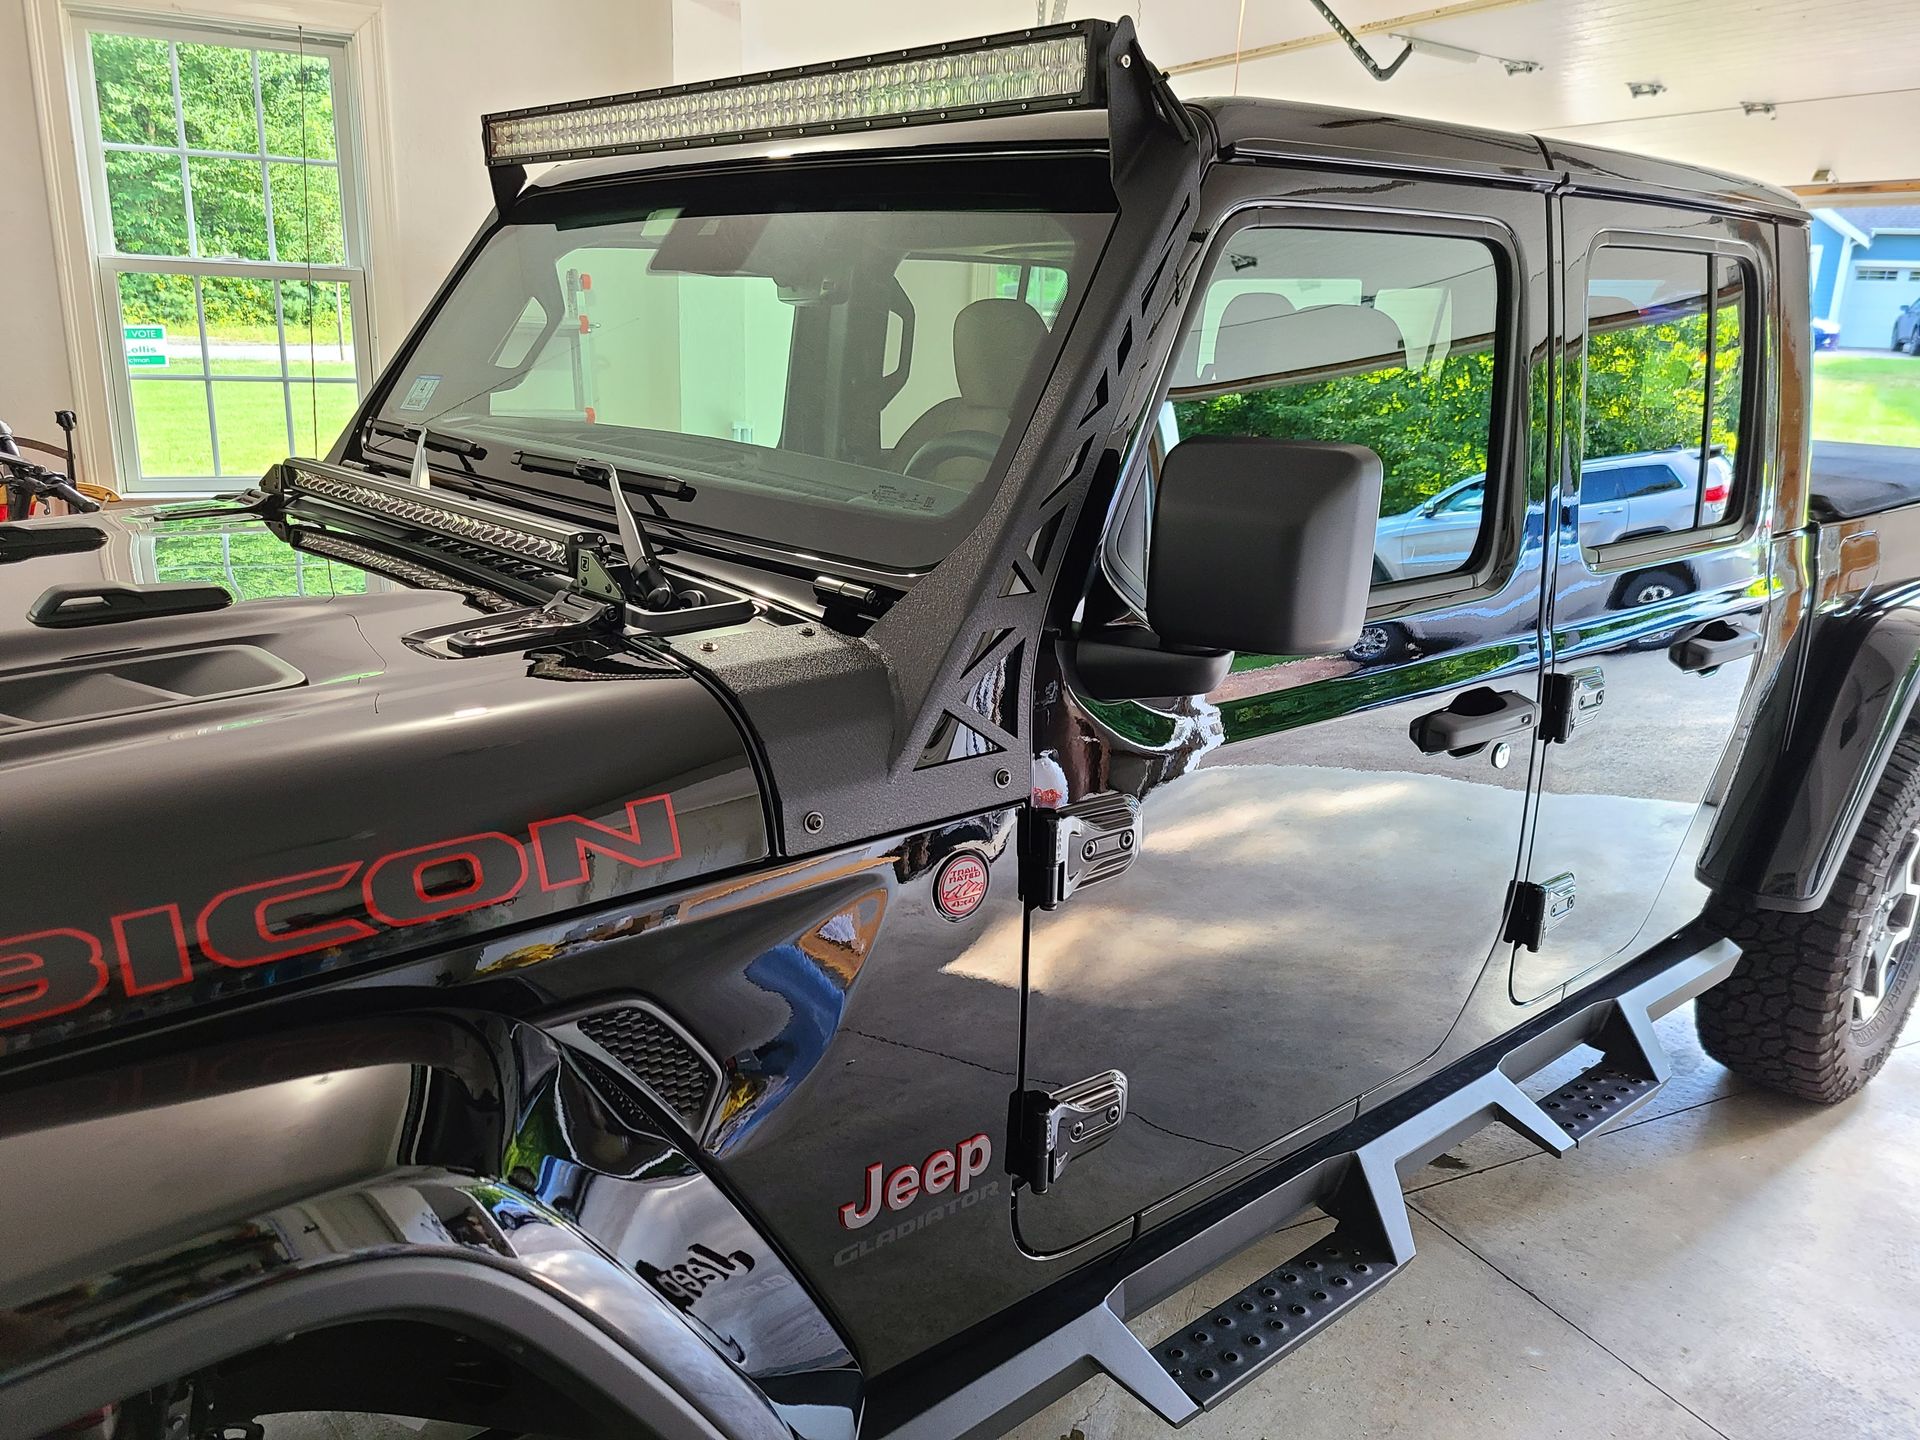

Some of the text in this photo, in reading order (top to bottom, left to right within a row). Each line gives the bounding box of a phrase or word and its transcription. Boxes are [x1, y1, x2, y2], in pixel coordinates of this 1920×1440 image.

[127, 345, 157, 353] ollis
[948, 871, 981, 884] RATED
[950, 866, 979, 878] TRAIL
[838, 1132, 992, 1230] Jeep
[833, 1181, 999, 1267] GLADIATOR
